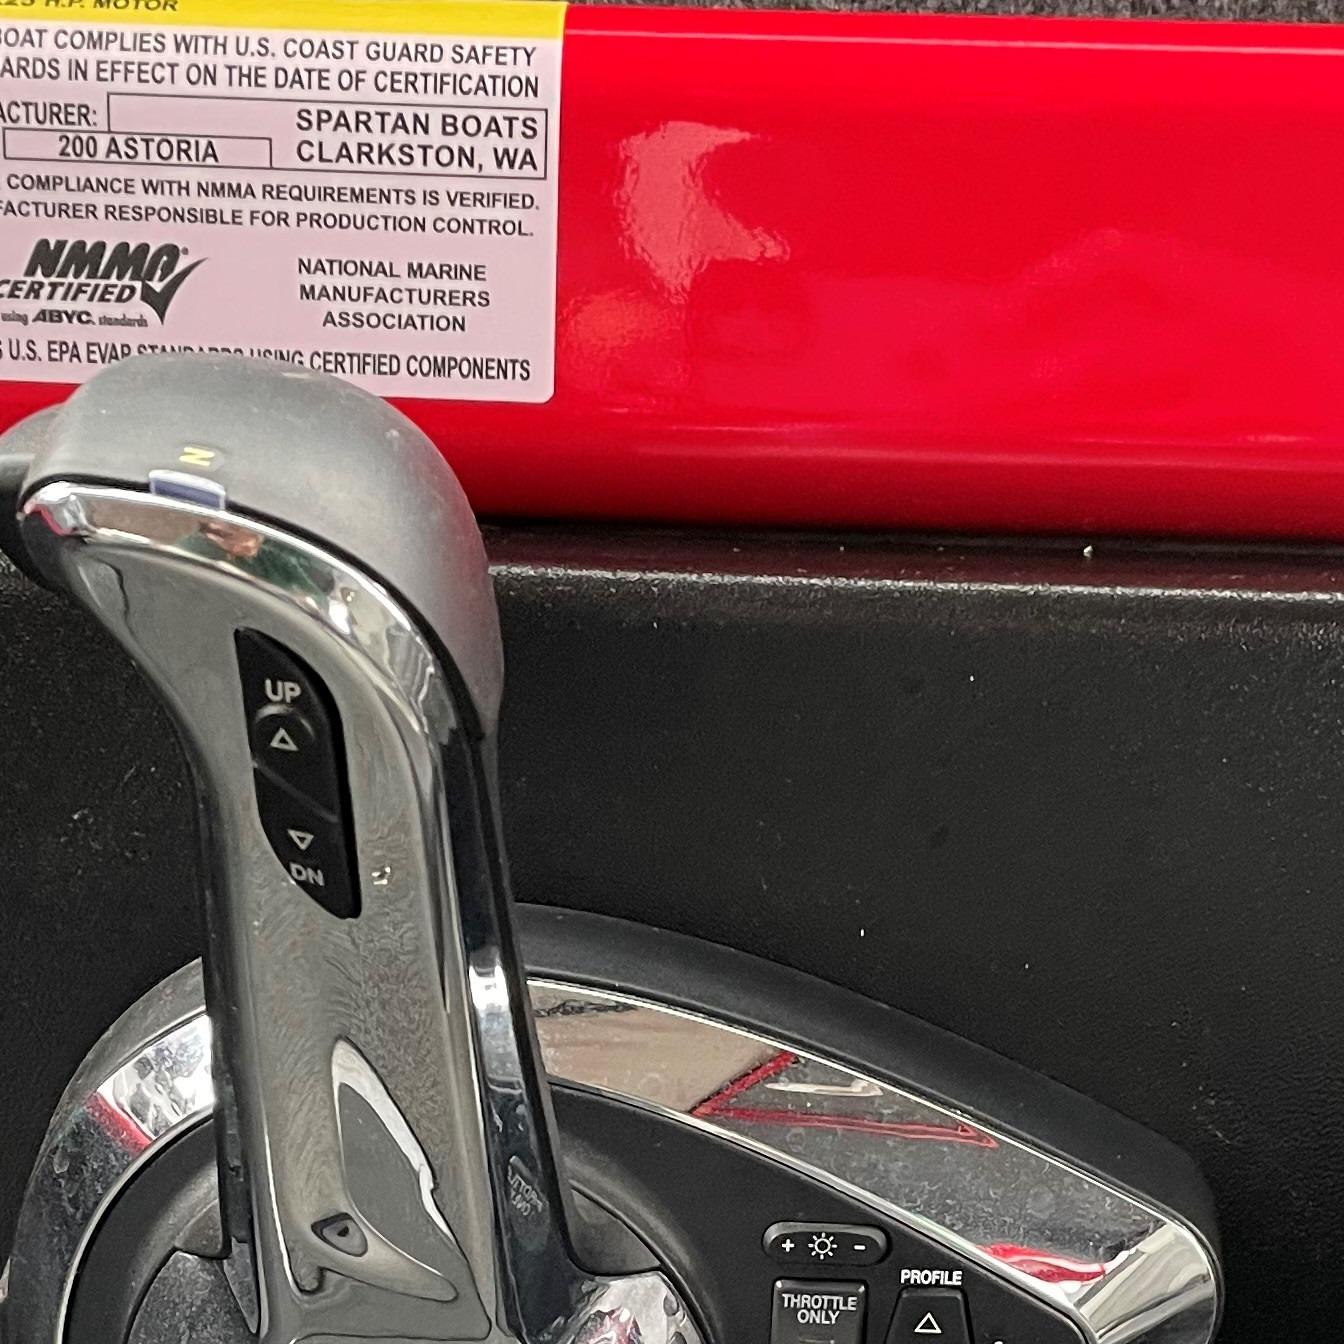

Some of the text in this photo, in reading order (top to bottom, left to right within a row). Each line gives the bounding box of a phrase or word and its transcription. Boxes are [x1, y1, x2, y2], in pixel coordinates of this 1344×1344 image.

[54, 29, 165, 53] COMPLIES
[173, 33, 228, 55] WITH
[235, 36, 275, 57] U.S.
[283, 38, 359, 60] COAST
[366, 41, 444, 63] GUARD
[451, 44, 536, 66] SAFETY
[68, 58, 88, 81] IN
[96, 60, 179, 85] EFFECT
[186, 63, 218, 86] ON
[225, 65, 267, 88] THE
[274, 67, 330, 91] DATE
[337, 68, 367, 91] OF
[374, 70, 539, 98] CERTIFICATION
[296, 109, 538, 139] SPARTAN BOATS
[58, 134, 98, 158] 200
[106, 136, 219, 163] ASTORIA
[296, 140, 538, 172] CLARKSTON, WA
[7, 172, 135, 195] COMPLIANCE
[142, 178, 191, 197] WITH
[197, 181, 256, 199] NMMA
[262, 183, 416, 206] REQUIREMENTS
[422, 189, 440, 206] IS
[446, 191, 540, 211] VERIFIED.
[106, 203, 243, 226] RESPONSIBLE
[250, 210, 290, 228] FOR
[296, 212, 426, 233] PRODUCTION
[433, 216, 534, 237] CONTROL.
[23, 238, 181, 282] NMMA
[297, 257, 487, 282] NATIONAL MARINE
[299, 284, 490, 308] MANUFACTURERS
[322, 311, 466, 332] ASSOCIATION
[8, 338, 42, 362] U.S.
[47, 341, 82, 363] EPA
[310, 350, 400, 376] CERTIFIED
[407, 355, 531, 381] COMPONENTS
[265, 679, 302, 704] UP
[289, 862, 324, 887] DN
[900, 1269, 963, 1286] PROFILE
[781, 1293, 857, 1311] THROTTLE
[797, 1309, 840, 1325] ONLY
